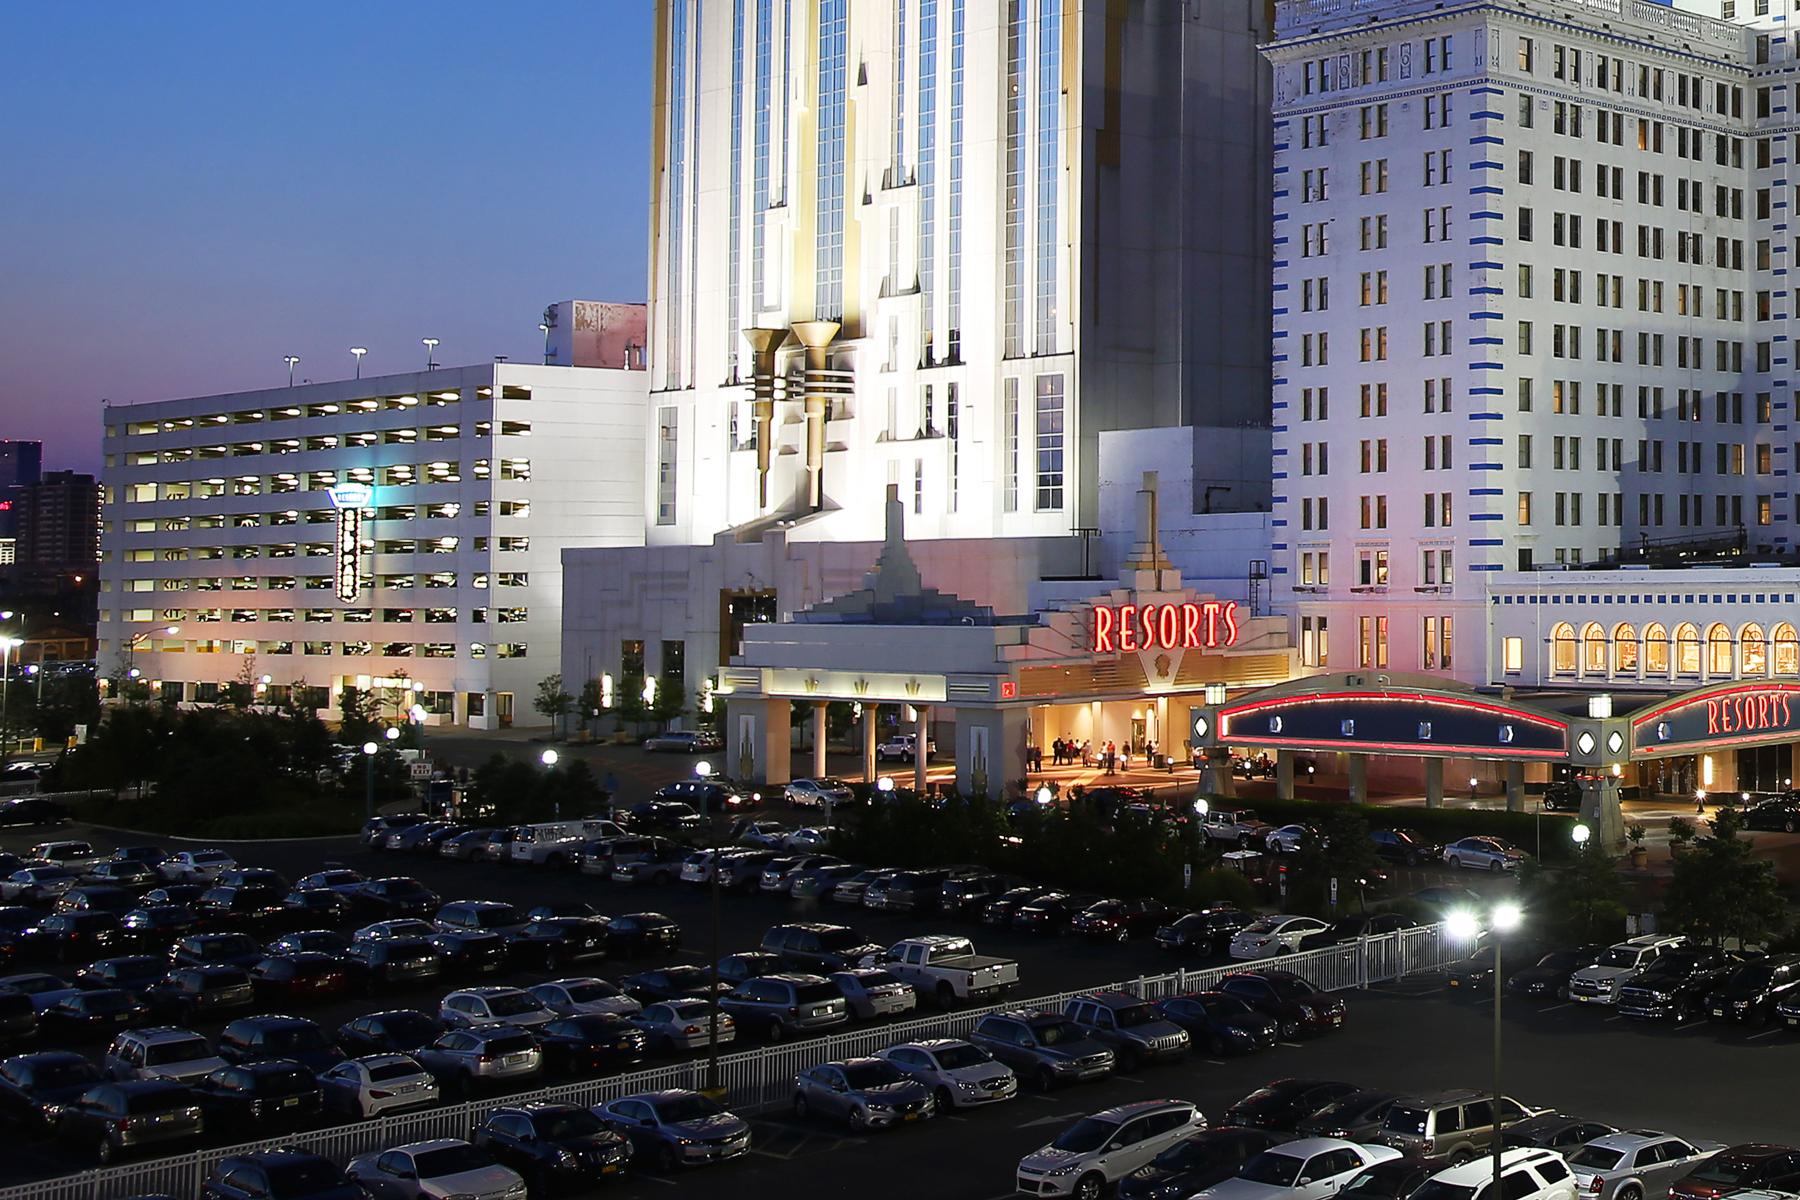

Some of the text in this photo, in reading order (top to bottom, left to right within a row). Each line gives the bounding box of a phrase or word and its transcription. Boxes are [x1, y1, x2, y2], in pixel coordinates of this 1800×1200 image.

[343, 554, 355, 597] PARK
[1093, 601, 1238, 652] RESORTS
[1707, 692, 1791, 735] RESORTS
